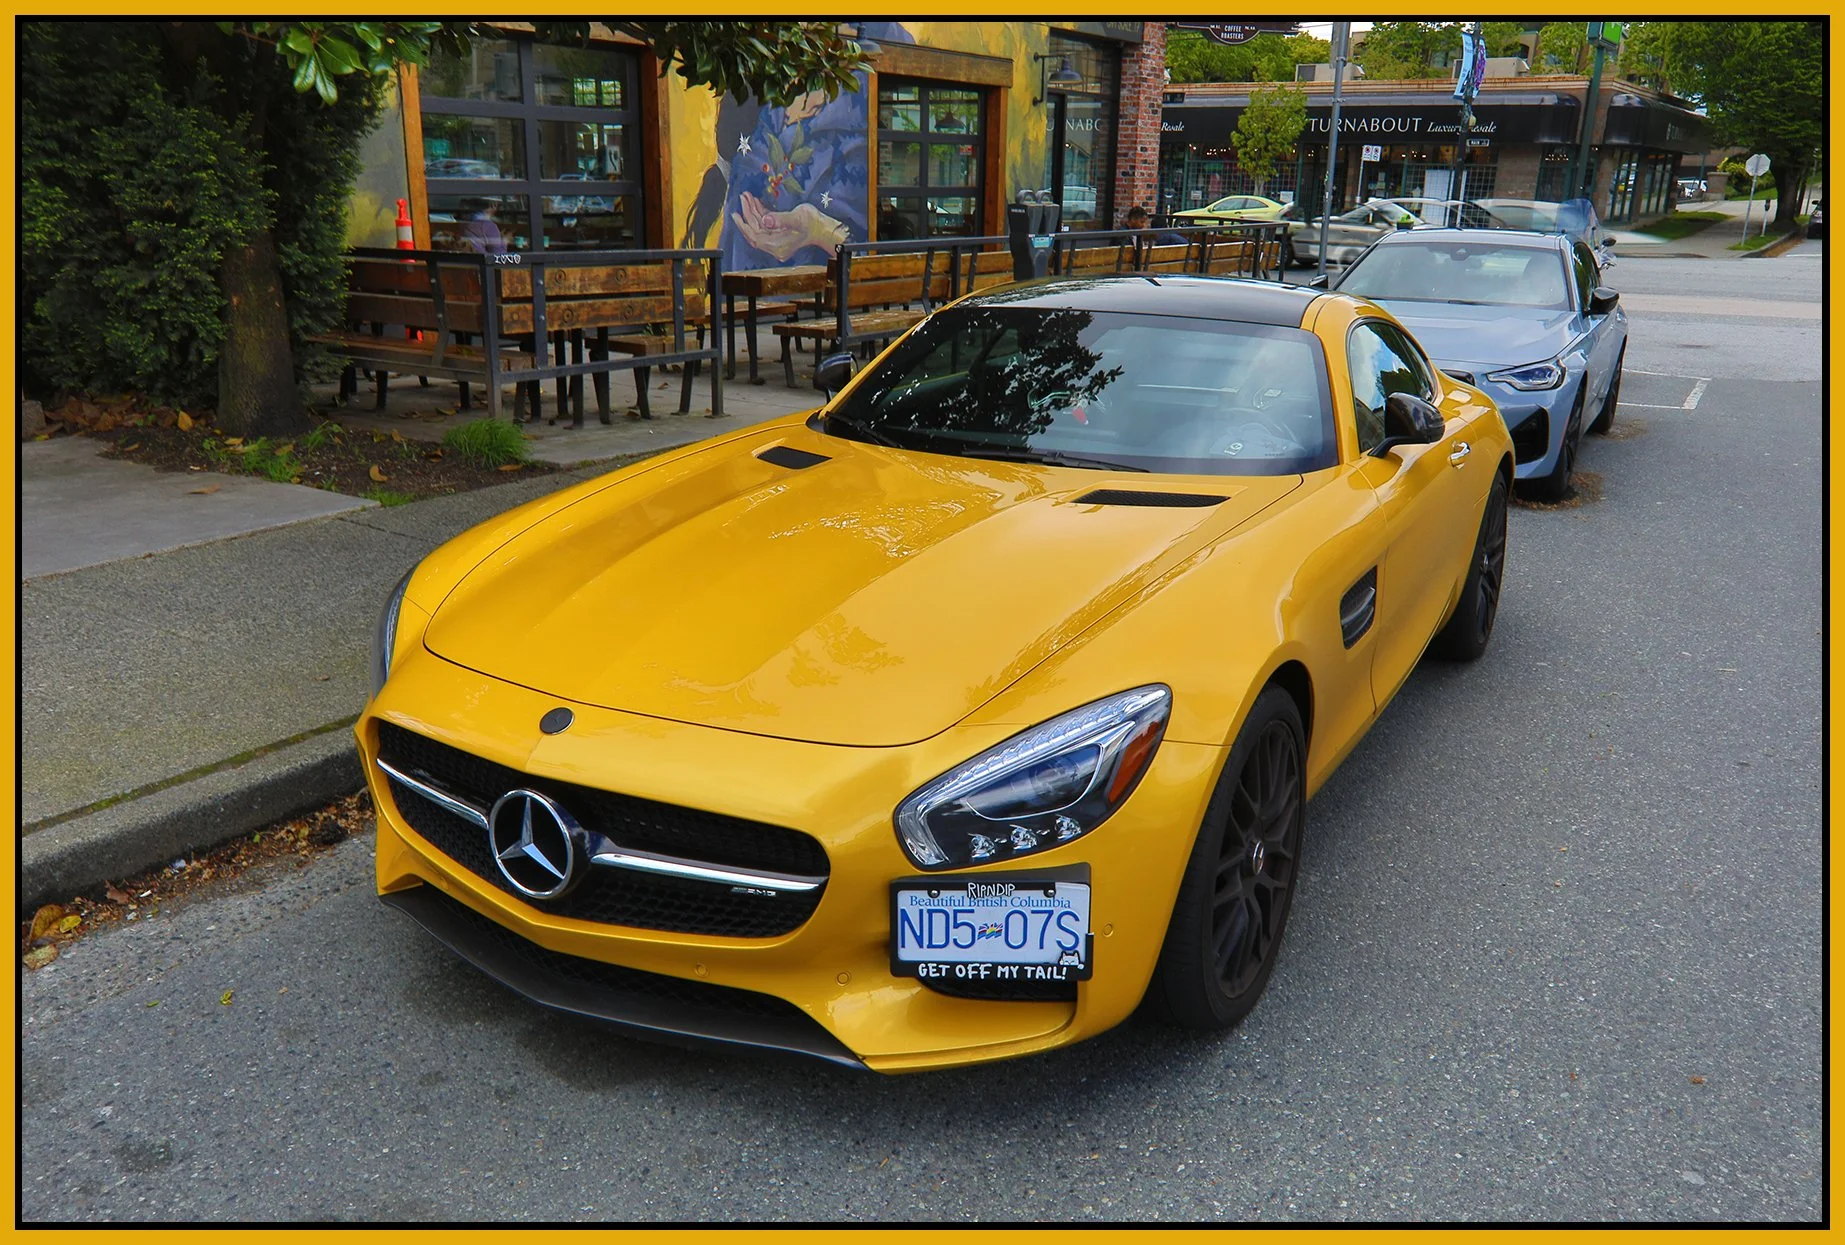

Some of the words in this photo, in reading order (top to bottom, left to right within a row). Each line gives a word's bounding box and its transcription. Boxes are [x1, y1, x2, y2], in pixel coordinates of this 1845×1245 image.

[1161, 121, 1185, 132] Resale
[967, 882, 1016, 898] RIPNDIP
[910, 895, 965, 907] Beautiful
[968, 896, 1008, 908] British
[1010, 896, 1071, 909] Columbia
[900, 908, 976, 949] ND5
[1004, 909, 1081, 951] 07S
[918, 963, 951, 977] GET
[955, 963, 994, 979] OFF
[997, 964, 1020, 979] MY
[1024, 966, 1068, 980] TAIL!
